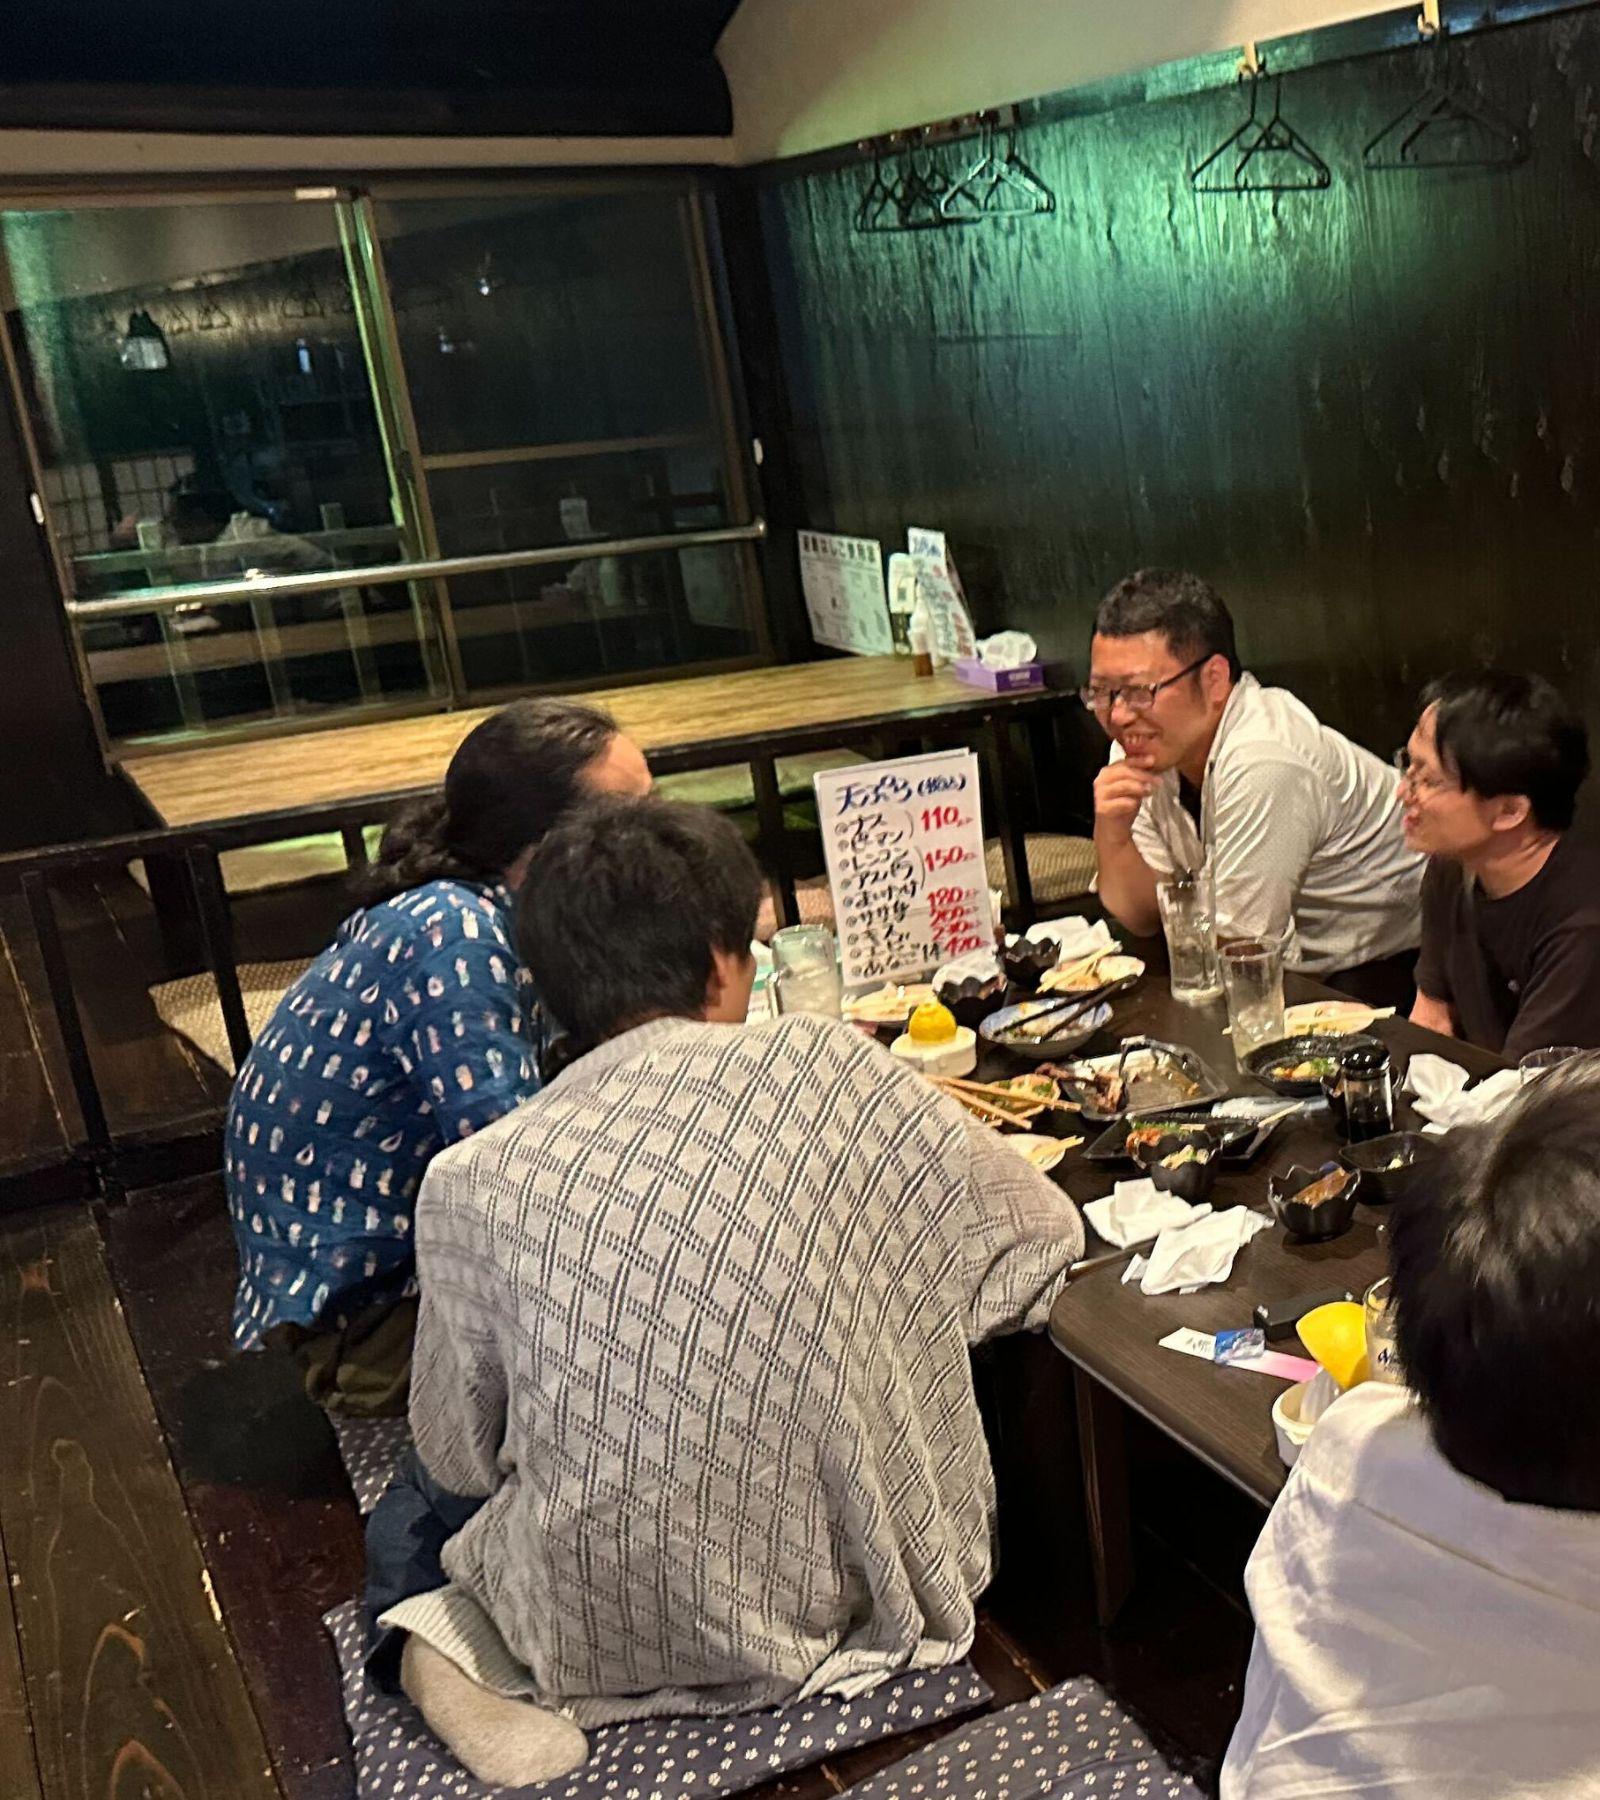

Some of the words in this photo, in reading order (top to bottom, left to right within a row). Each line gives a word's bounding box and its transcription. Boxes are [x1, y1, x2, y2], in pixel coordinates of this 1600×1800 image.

[835, 774, 912, 815] 天ぷら
[850, 813, 887, 835] ナス
[852, 847, 909, 870] レンコン
